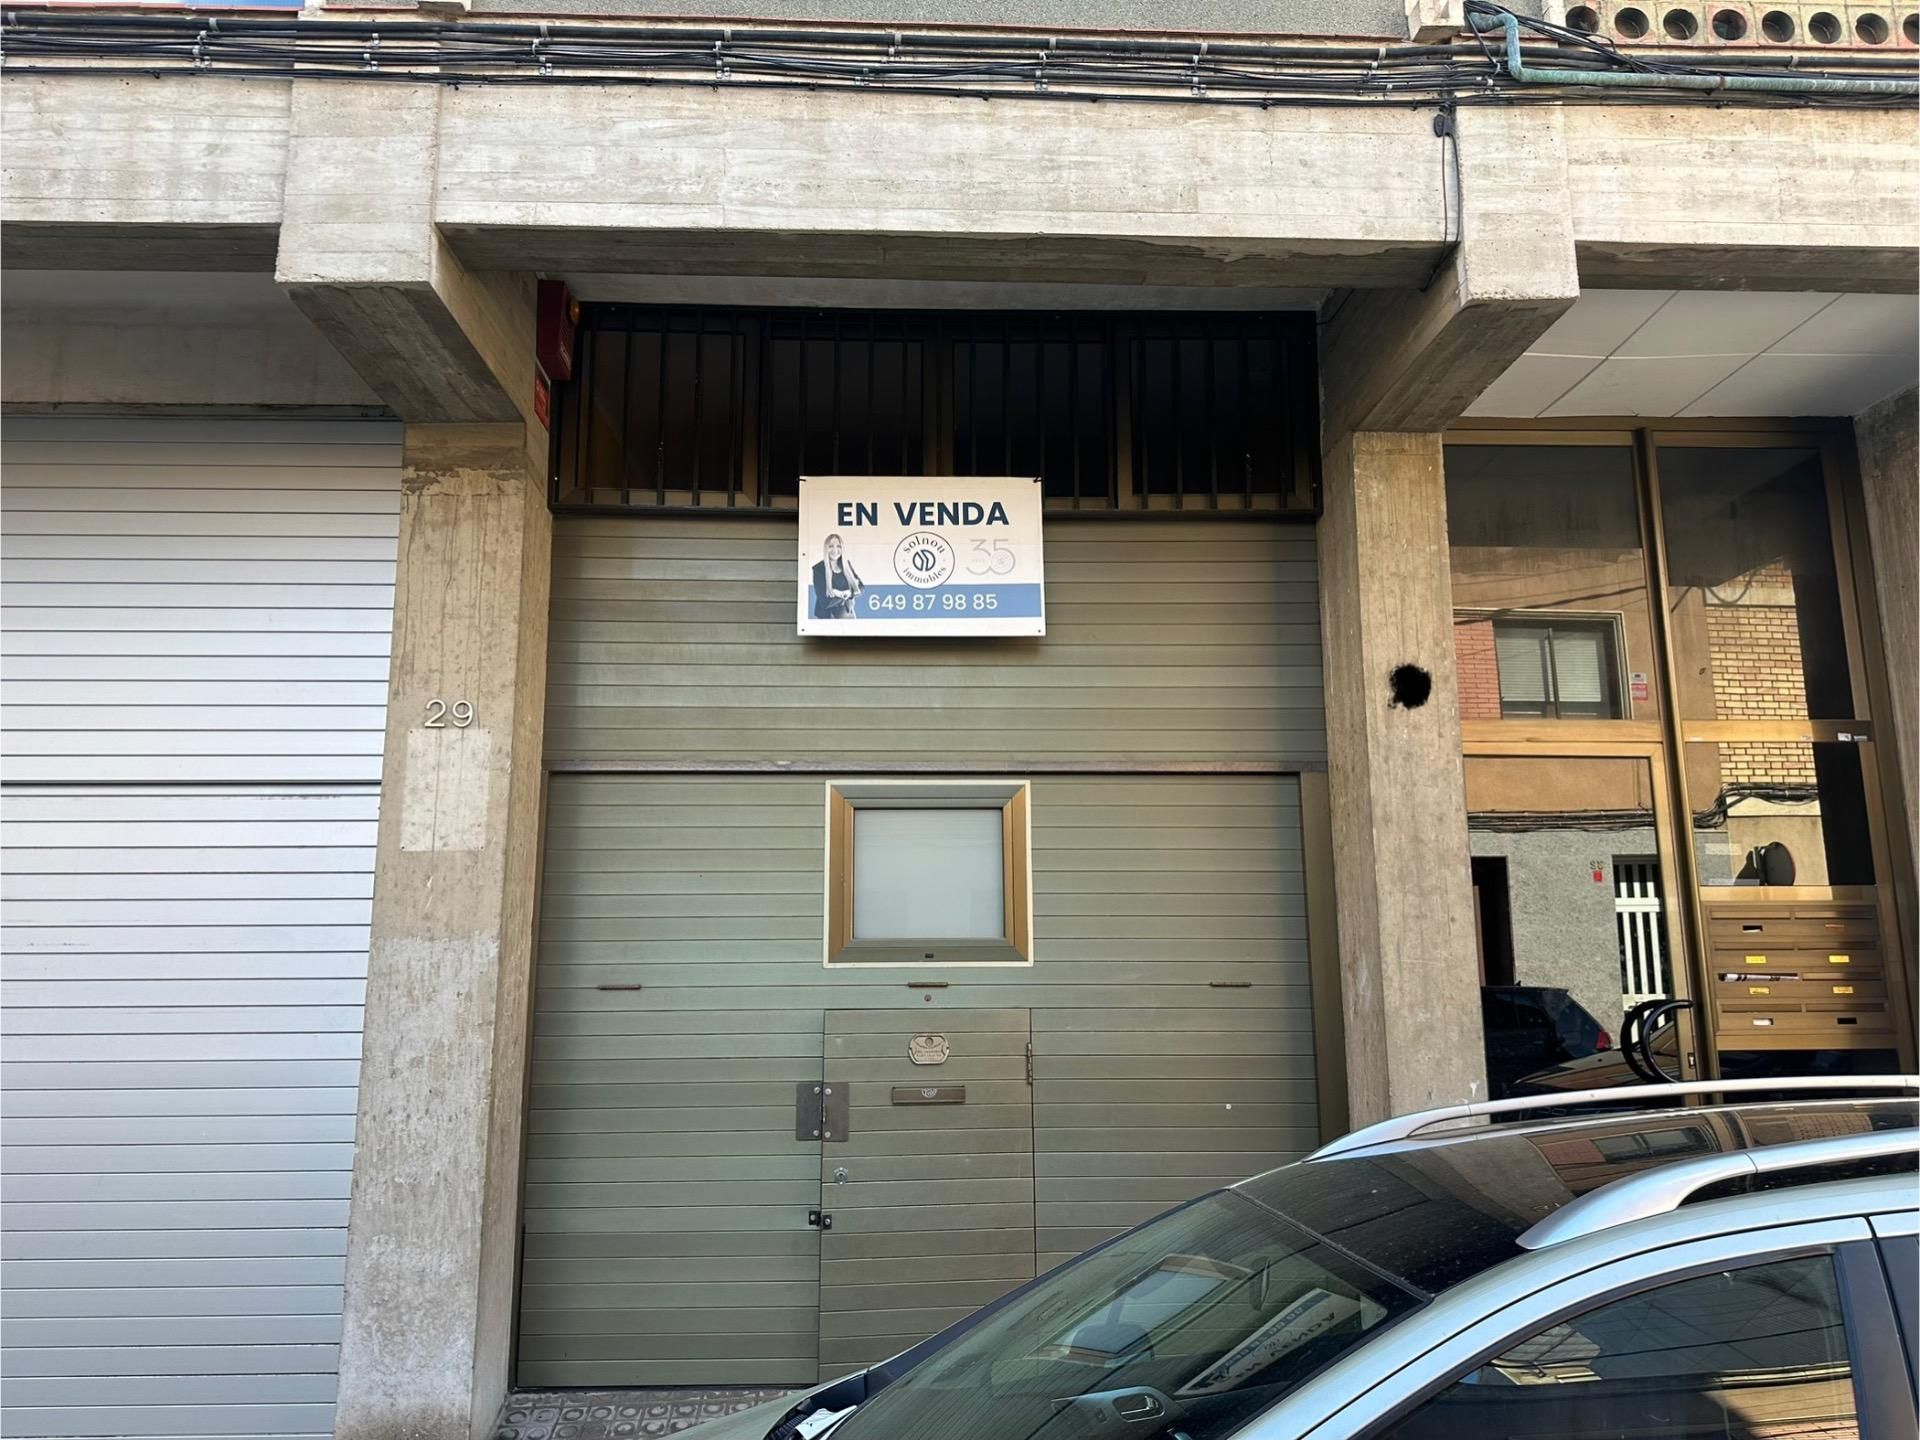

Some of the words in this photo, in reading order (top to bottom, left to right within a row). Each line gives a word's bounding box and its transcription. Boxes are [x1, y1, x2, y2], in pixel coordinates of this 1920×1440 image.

[837, 503, 878, 526] EN
[894, 502, 1009, 526] VENDA
[903, 535, 946, 554] solnou
[966, 538, 1016, 575] 35
[903, 566, 947, 584] immobles
[868, 594, 906, 610] 649
[912, 594, 936, 610] 87
[942, 594, 967, 610] 98
[972, 594, 998, 610] 85
[424, 699, 474, 728] 29
